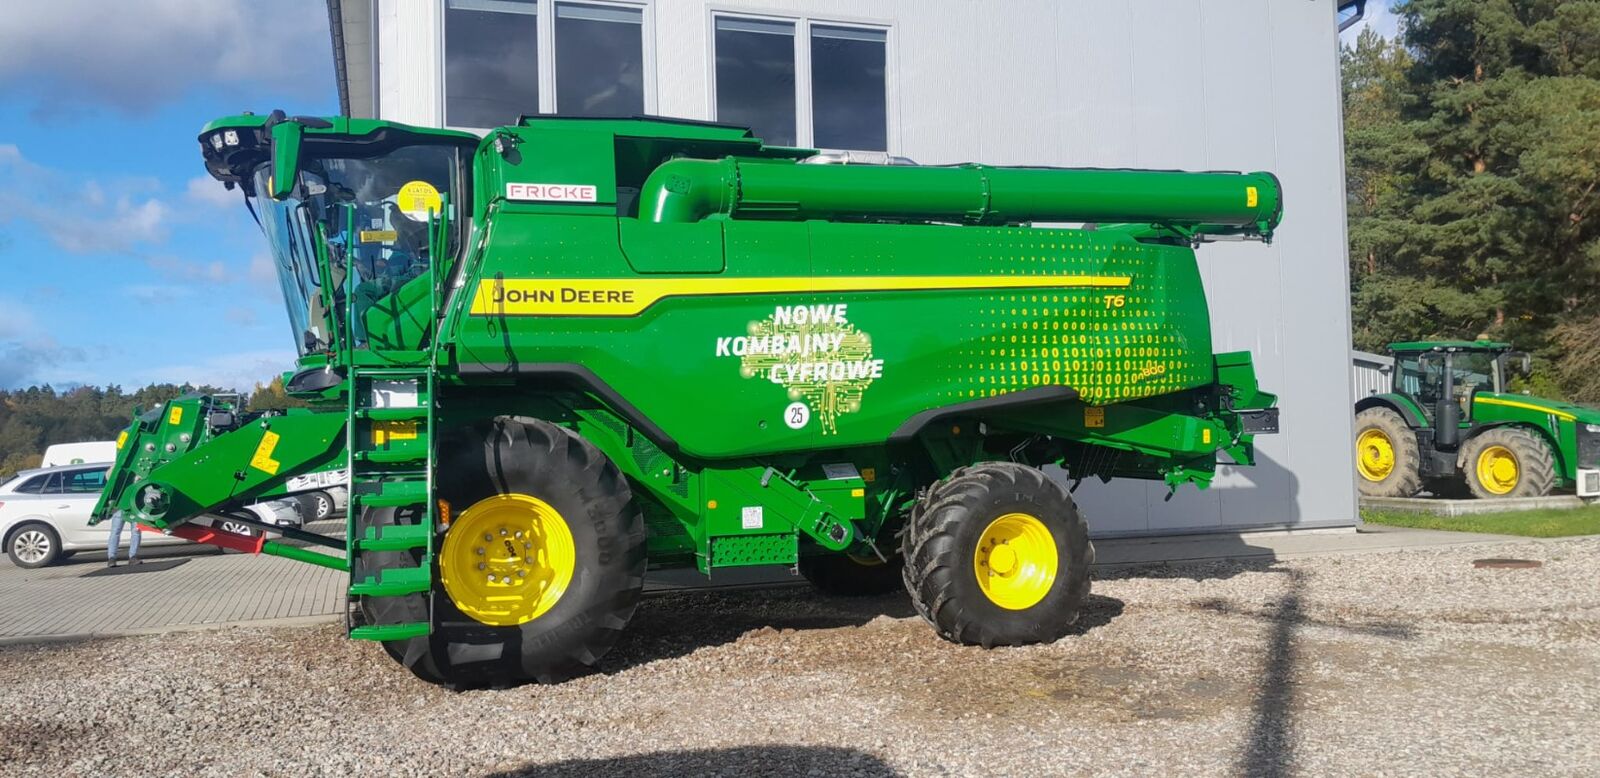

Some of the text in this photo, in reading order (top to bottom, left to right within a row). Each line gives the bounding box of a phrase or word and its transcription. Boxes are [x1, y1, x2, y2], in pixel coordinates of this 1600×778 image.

[510, 185, 593, 199] FRICKE
[493, 287, 635, 303] JOHN DEERE
[1104, 295, 1125, 309] T6
[773, 304, 848, 325] NOWE
[716, 333, 845, 357] KOMBAJNY
[770, 359, 884, 384] CYFROWE
[791, 407, 803, 424] 25
